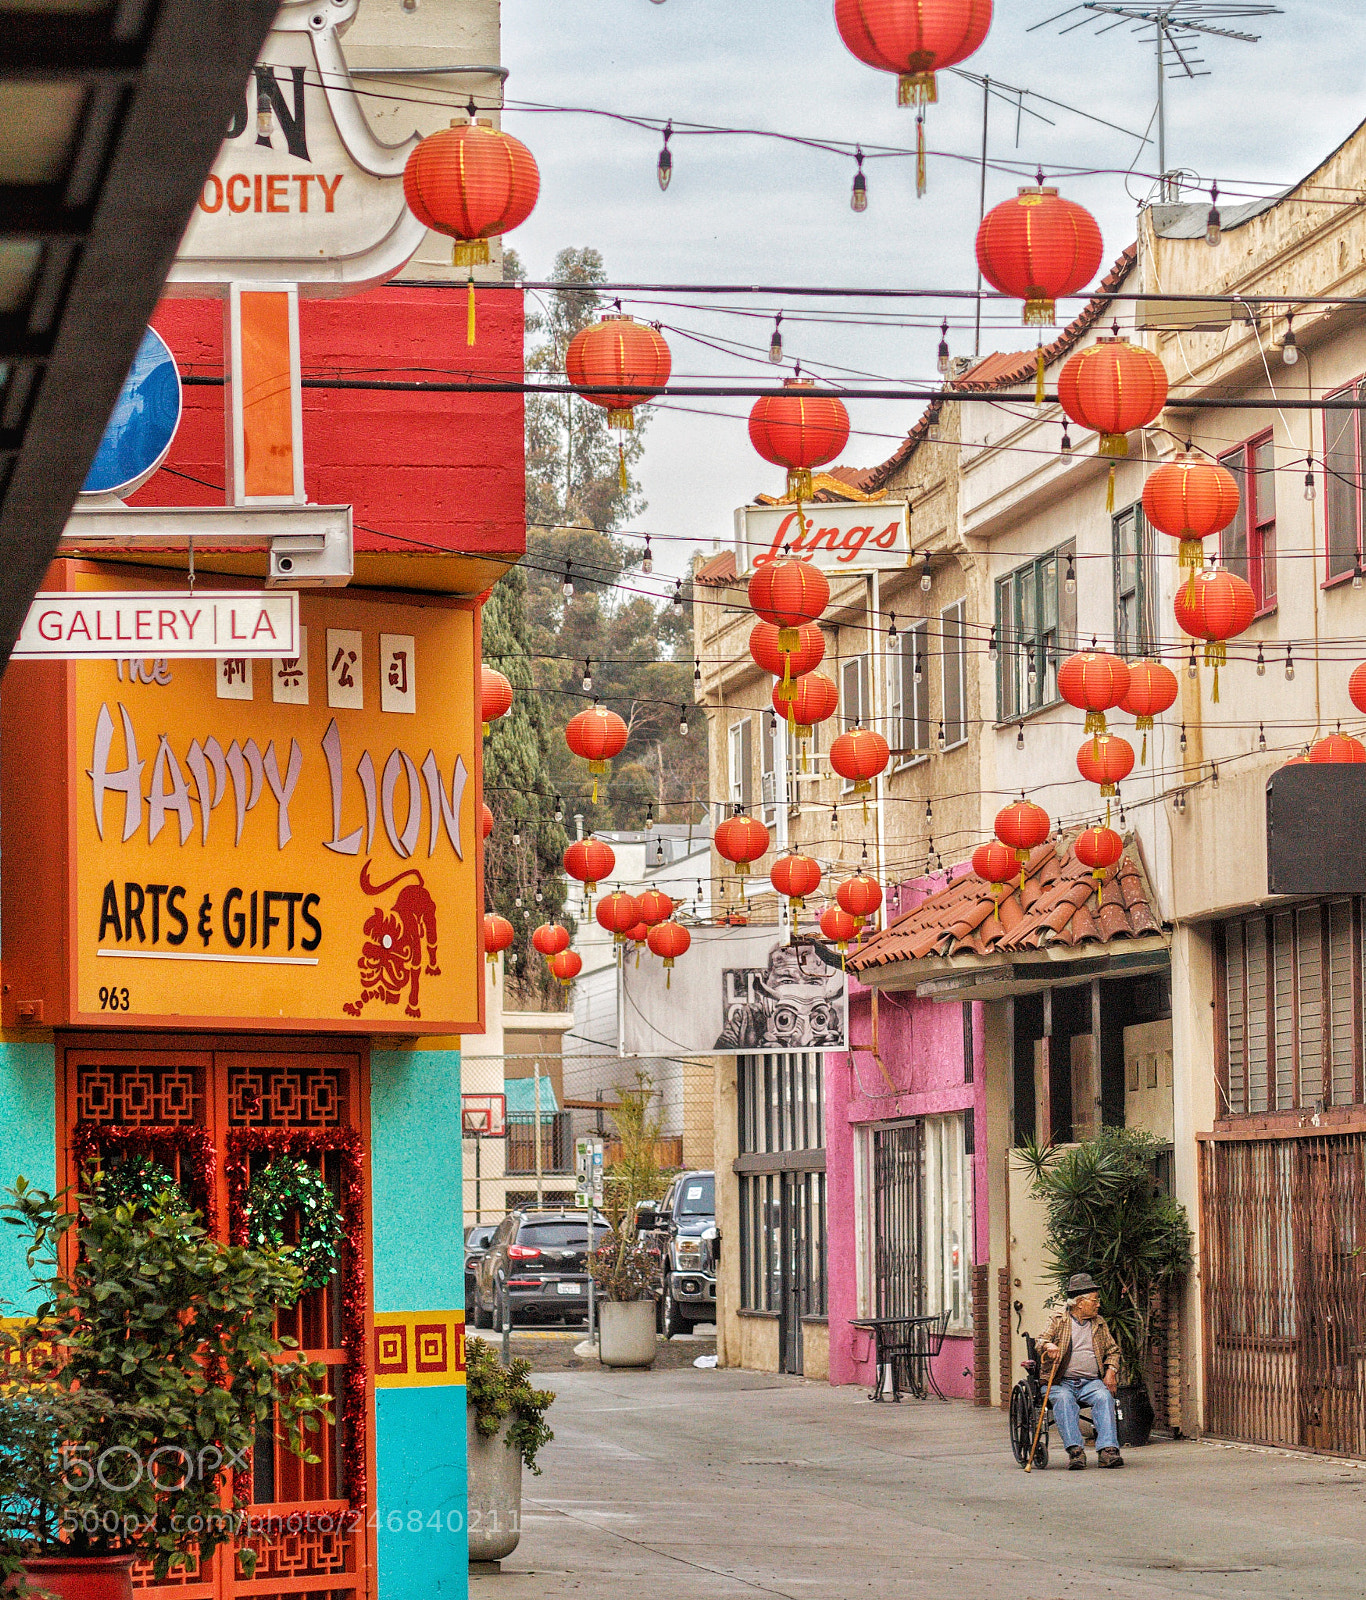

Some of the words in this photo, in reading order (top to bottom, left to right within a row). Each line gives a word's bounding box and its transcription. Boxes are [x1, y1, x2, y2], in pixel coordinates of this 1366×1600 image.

[752, 511, 900, 568] Lings
[38, 609, 202, 641] GALLERY
[230, 609, 277, 640] LA
[98, 879, 189, 946] ARTS
[197, 893, 213, 947] &
[222, 887, 322, 951] GIFTS
[98, 986, 130, 1011] 963
